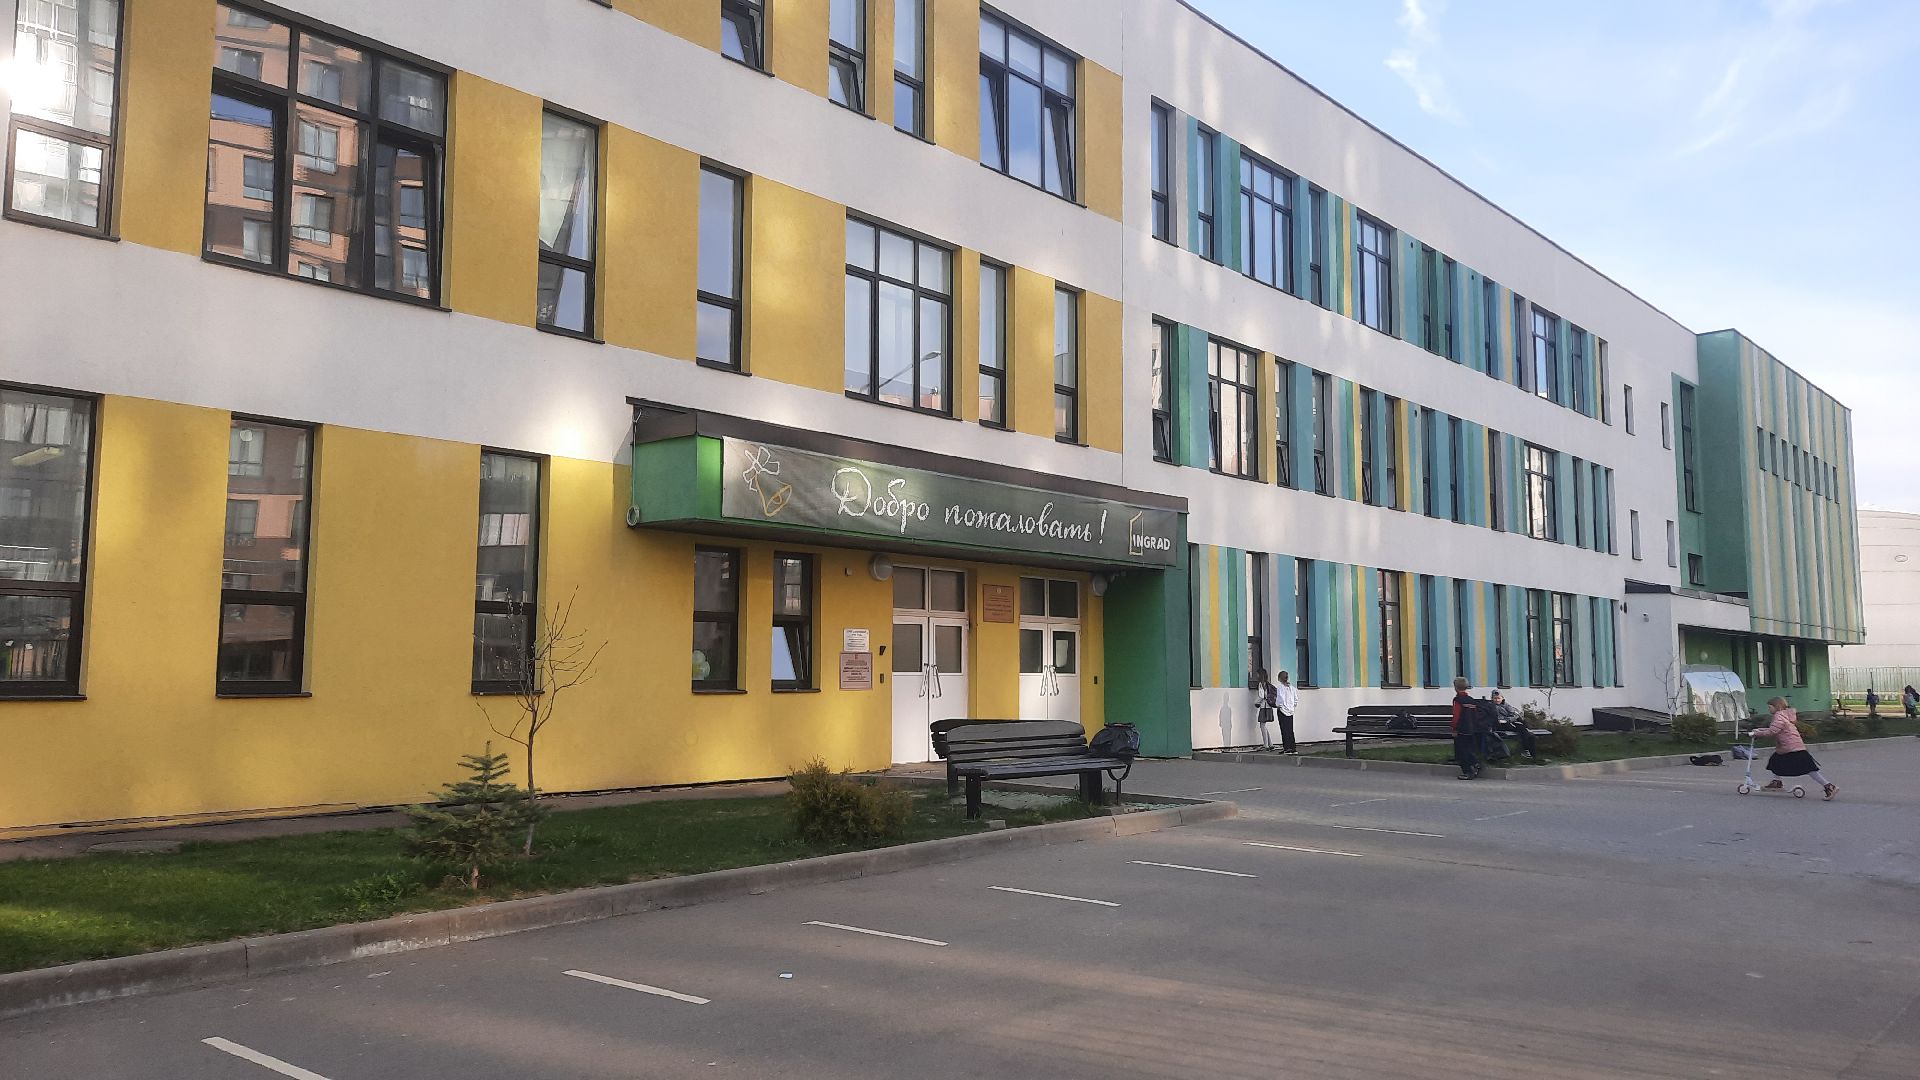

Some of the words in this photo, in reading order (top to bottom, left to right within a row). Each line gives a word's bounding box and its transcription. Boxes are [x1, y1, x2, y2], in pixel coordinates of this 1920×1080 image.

[831, 467, 930, 535] Добро
[944, 502, 1107, 544] пожаловать!
[1132, 533, 1171, 551] INGRAD
